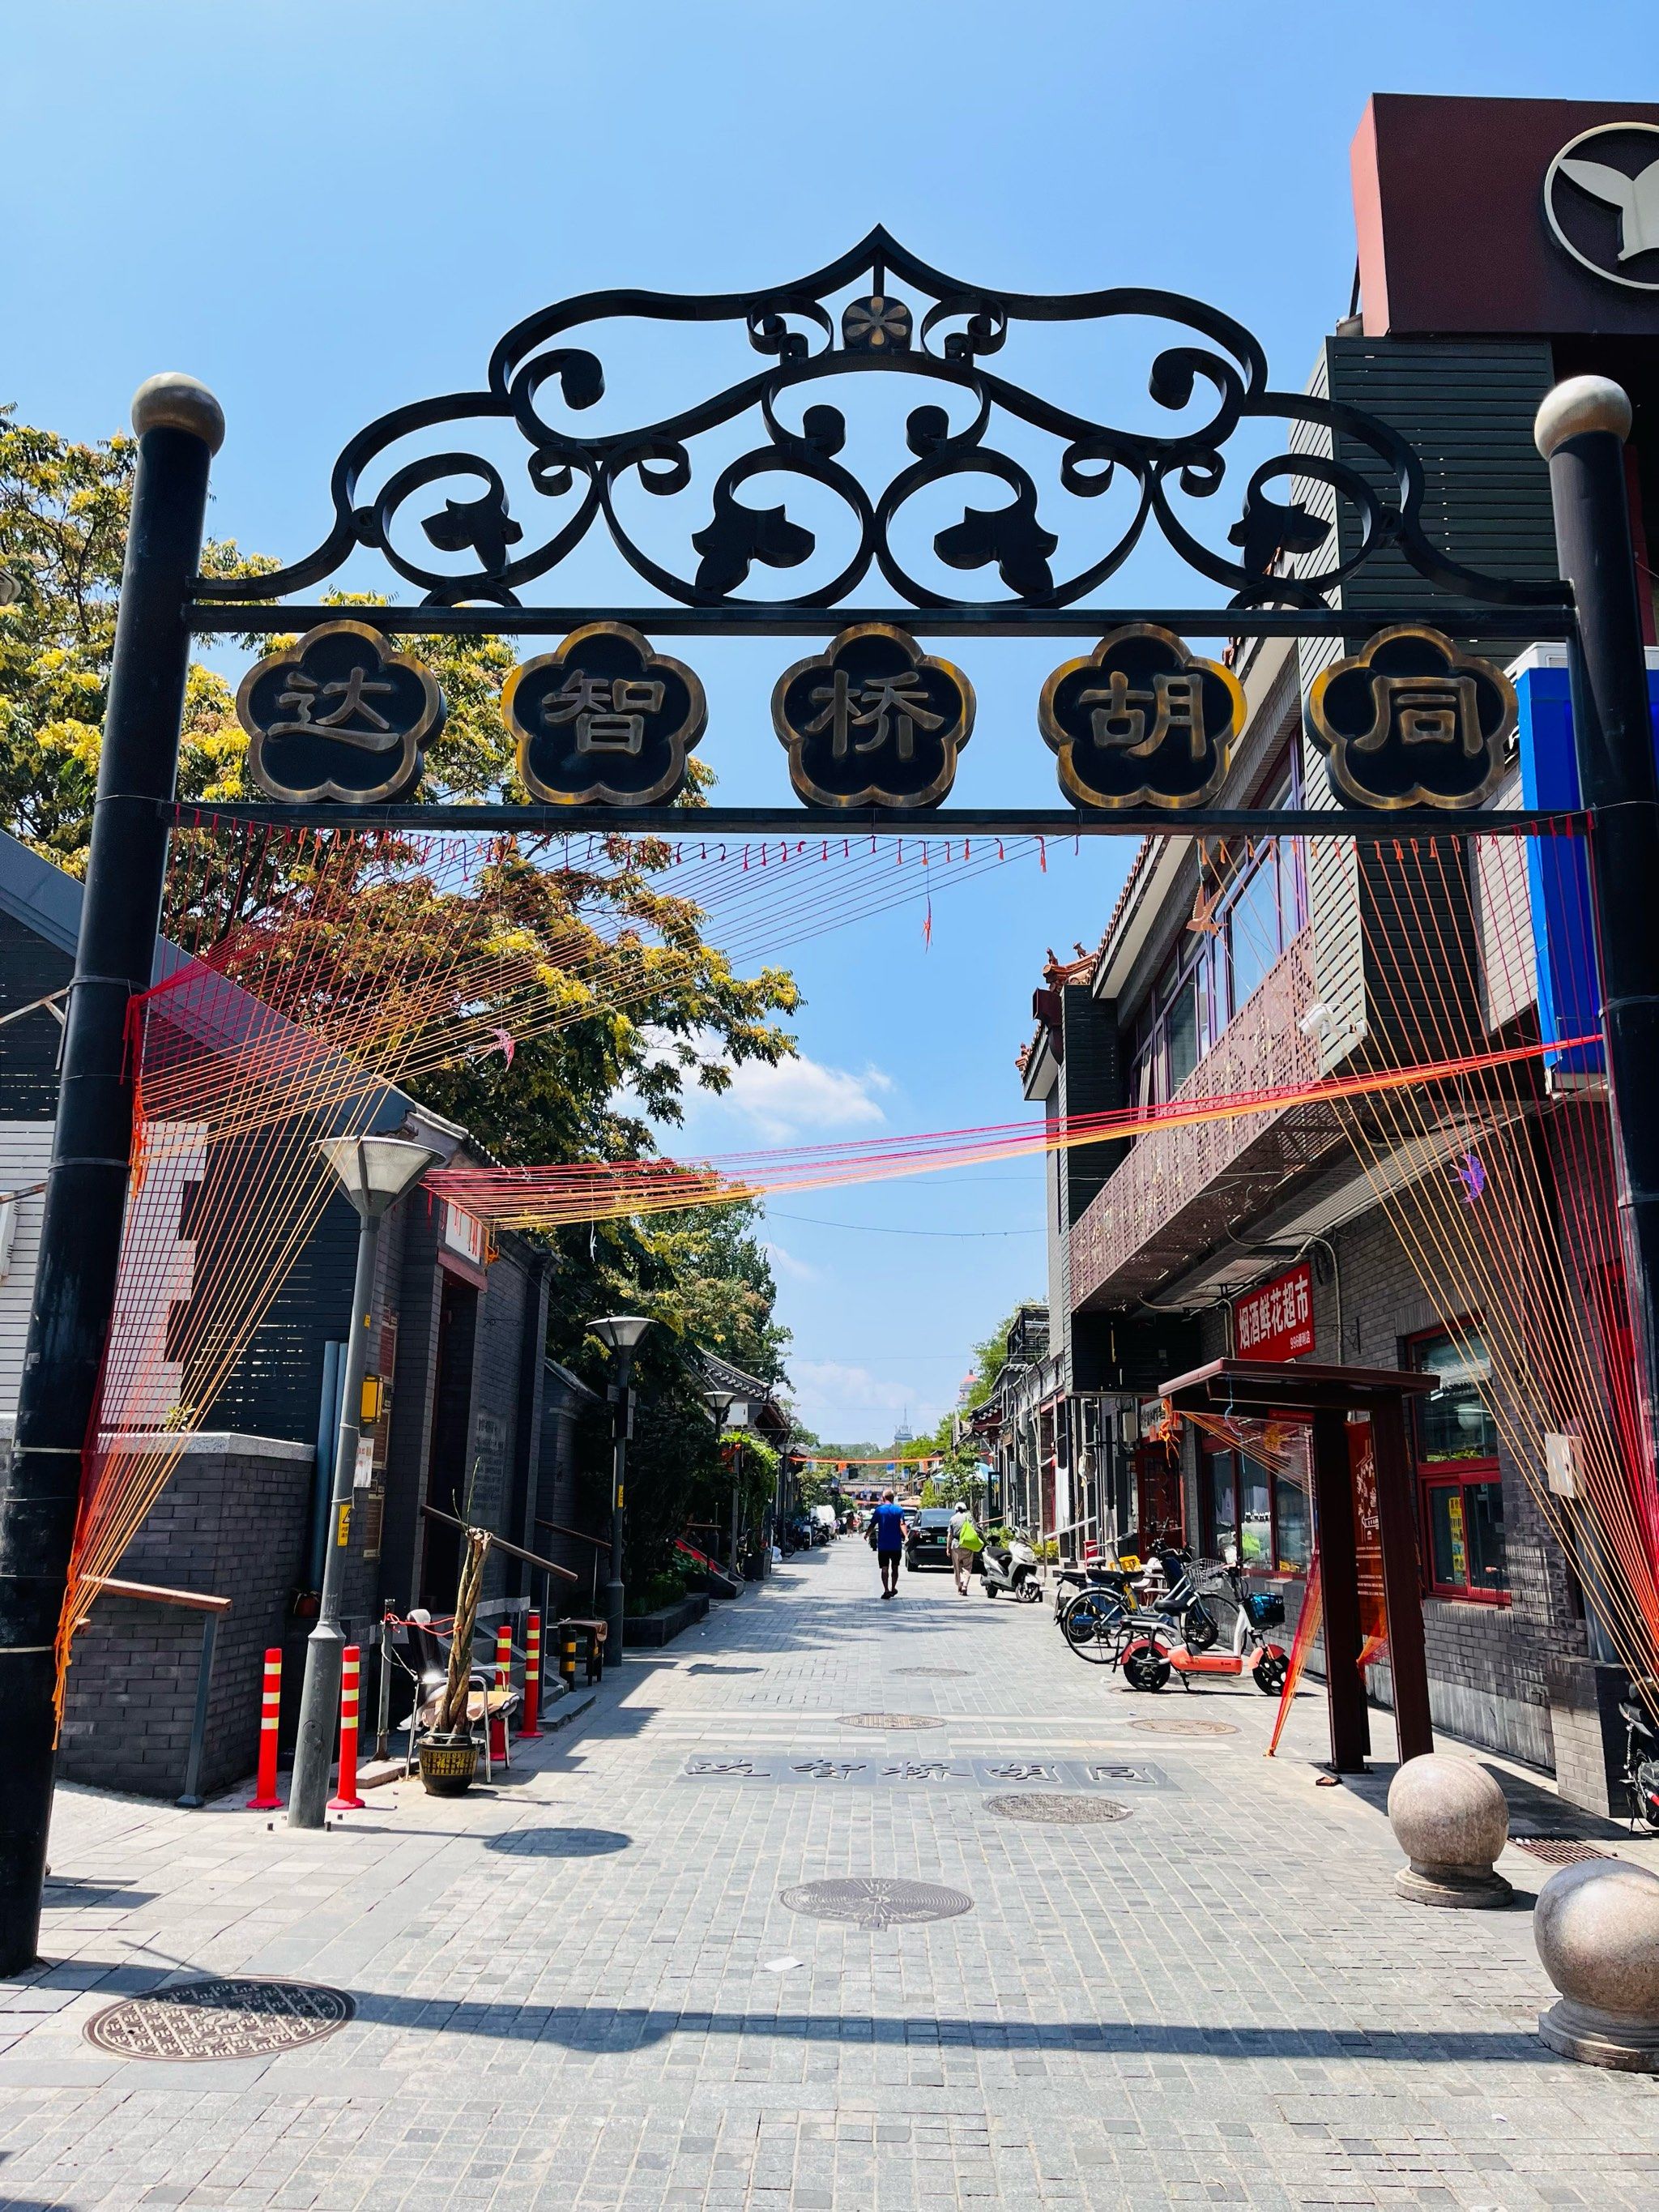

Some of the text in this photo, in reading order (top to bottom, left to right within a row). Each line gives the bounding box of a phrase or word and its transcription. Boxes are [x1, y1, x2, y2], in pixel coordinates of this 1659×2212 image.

[266, 666, 1479, 758] 达智桥胡同
[1239, 1274, 1308, 1350] 烟酒鲜花超市
